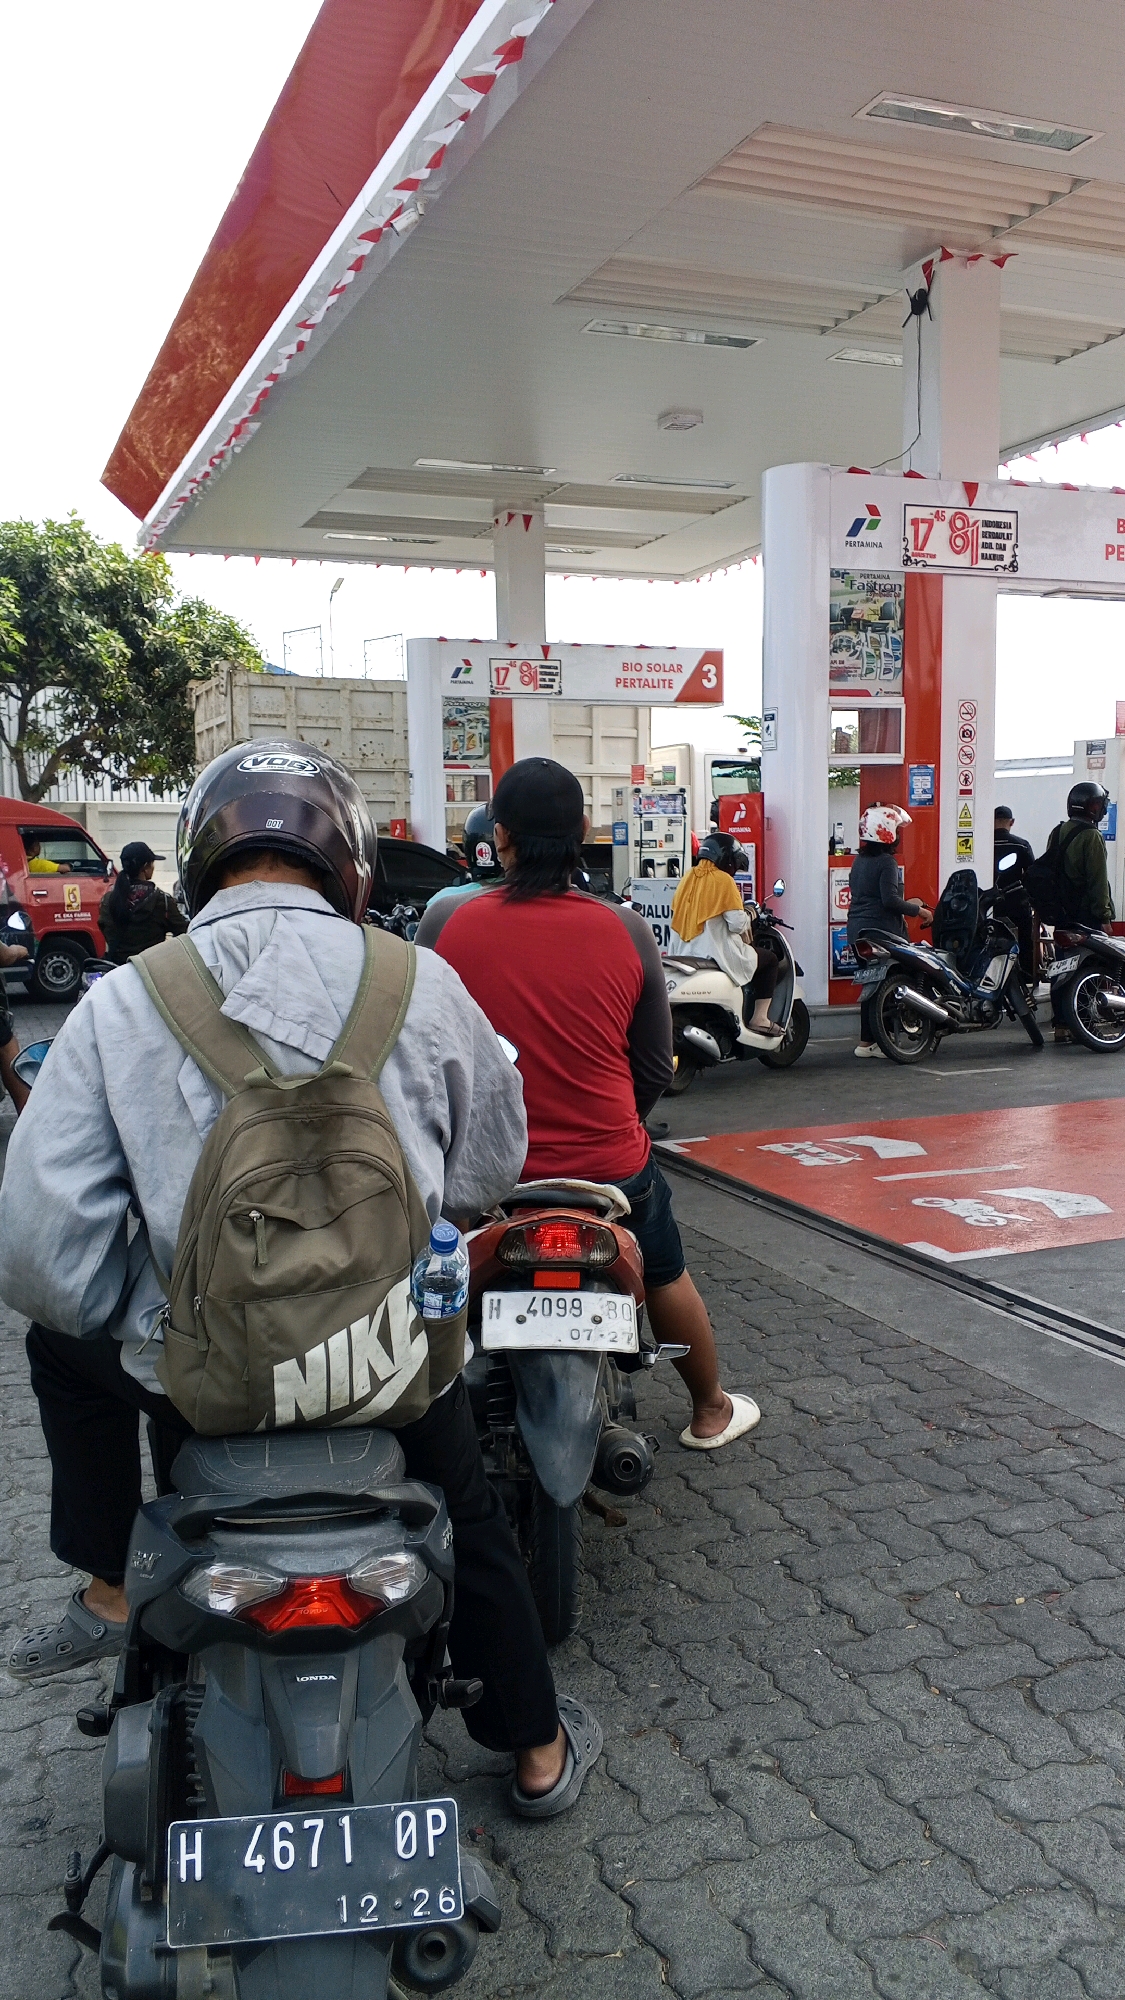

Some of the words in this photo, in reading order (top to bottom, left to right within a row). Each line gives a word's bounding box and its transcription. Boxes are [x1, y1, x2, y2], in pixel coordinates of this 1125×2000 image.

[910, 517, 934, 552] 17
[981, 519, 1012, 530] INDONESIA
[845, 540, 883, 549] PERTAMINA
[949, 511, 980, 566] 81
[850, 580, 903, 593] Fastron
[859, 573, 890, 581] PERTAMINA
[494, 666, 510, 686] 17
[519, 661, 538, 692] 81
[622, 661, 643, 673] BIO
[646, 662, 683, 674] SOLAR
[701, 663, 718, 689] 3
[615, 677, 674, 690] PERTALITE
[266, 818, 283, 829] DOT
[488, 1298, 502, 1320] H
[526, 1296, 583, 1318] 4099
[273, 1275, 425, 1427] NIKE
[179, 1829, 203, 1883] H
[243, 1814, 352, 1874] 4671
